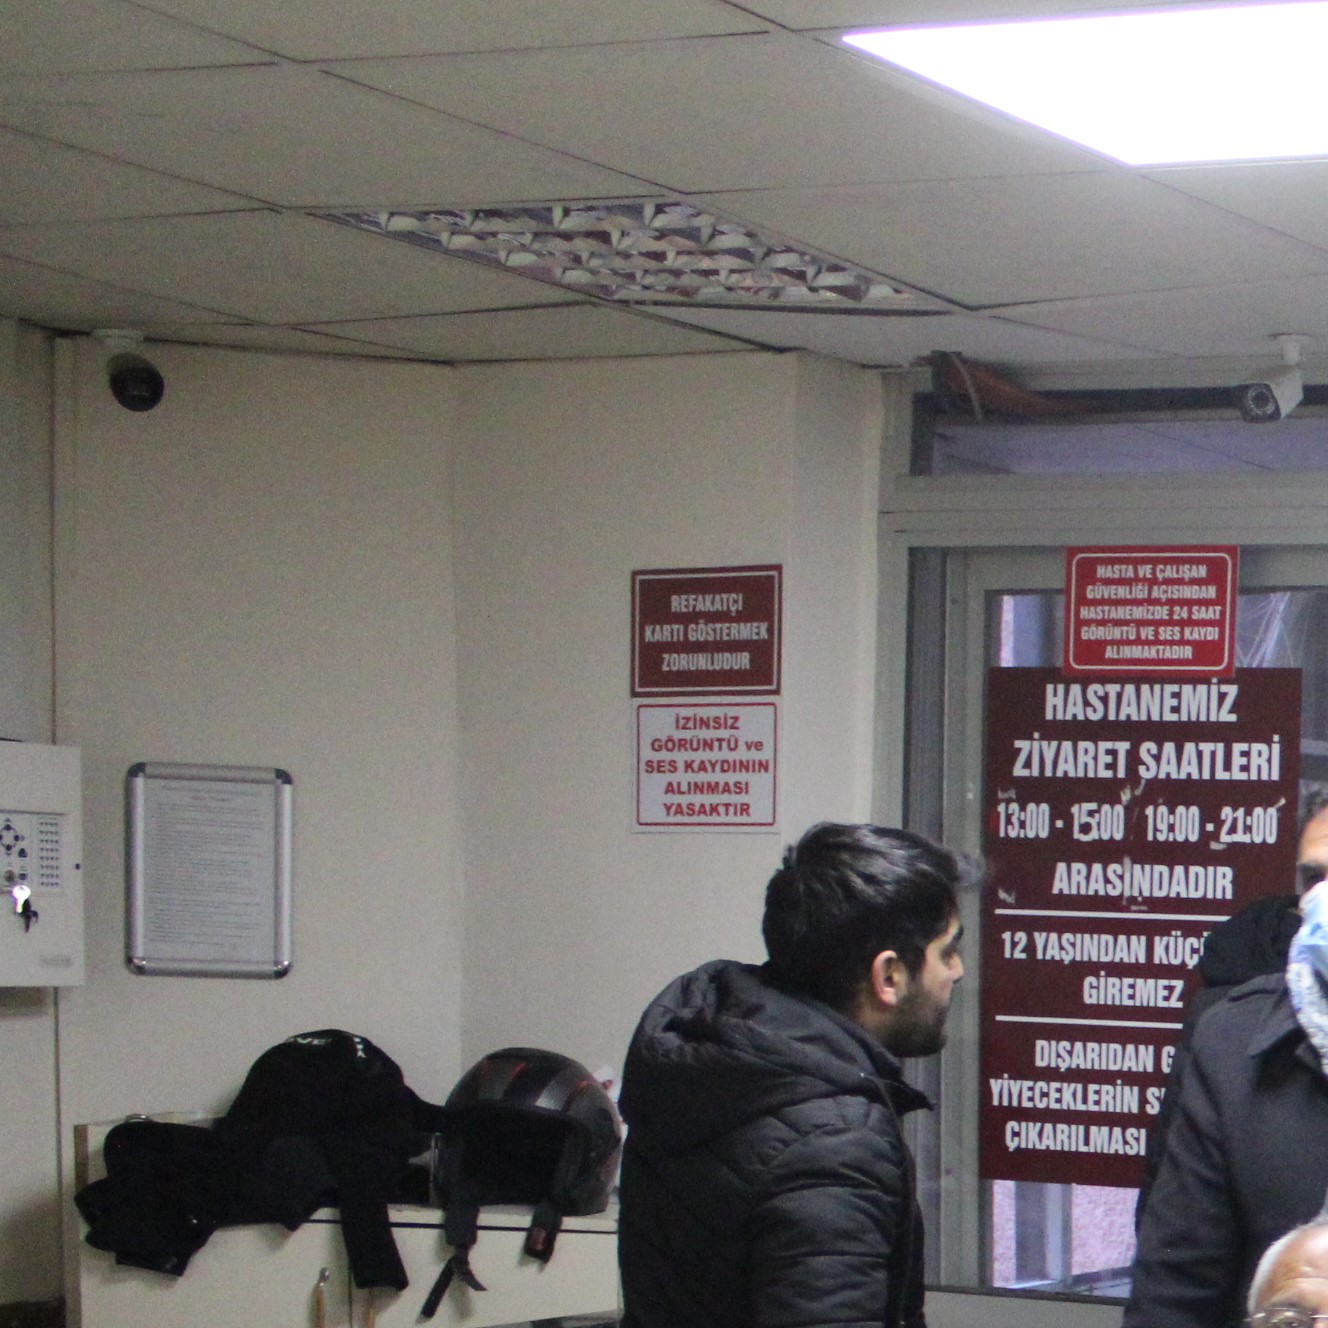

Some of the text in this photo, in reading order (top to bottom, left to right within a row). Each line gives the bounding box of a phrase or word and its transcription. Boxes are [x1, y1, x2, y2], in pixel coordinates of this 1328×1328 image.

[1097, 565, 1206, 582] HASTA VE ÇALIŞAN
[1086, 581, 1217, 601] GÜVENLİĞİ AÇISINDAN
[1080, 603, 1221, 620] HASTANEMİZDE 24 SAAT
[645, 620, 768, 642] KARTI GÖSTERMEK
[1081, 623, 1219, 641] GÖRÜNTÜ VE SES KAYDI
[662, 652, 750, 671] ZORUNLUDUR
[1105, 645, 1193, 660] ALINMAKTADIR
[1045, 677, 1239, 722] HASTANEMİZ
[675, 713, 740, 731] İZİNSİZ
[651, 735, 763, 752] GÖRÜNTÜ ve
[1012, 731, 1281, 781] ZİYARET SAATLERİ
[645, 759, 769, 774] SES KAYDININ
[664, 781, 749, 796] ALINMASI
[663, 802, 751, 817] YASAKTIR
[997, 802, 1050, 839] 13:00
[1145, 804, 1200, 842] 19:00
[1052, 861, 1234, 900] ARASINDADIR
[1001, 931, 1028, 959] 12
[1033, 932, 1147, 965] YAŞINDAN
[1083, 971, 1184, 1008] GİREMEZ
[1035, 1040, 1154, 1073] DIŞARIDAN
[989, 1074, 1139, 1114] YİYECEKLERİN
[1005, 1120, 1147, 1156] ÇIKARILMASI
